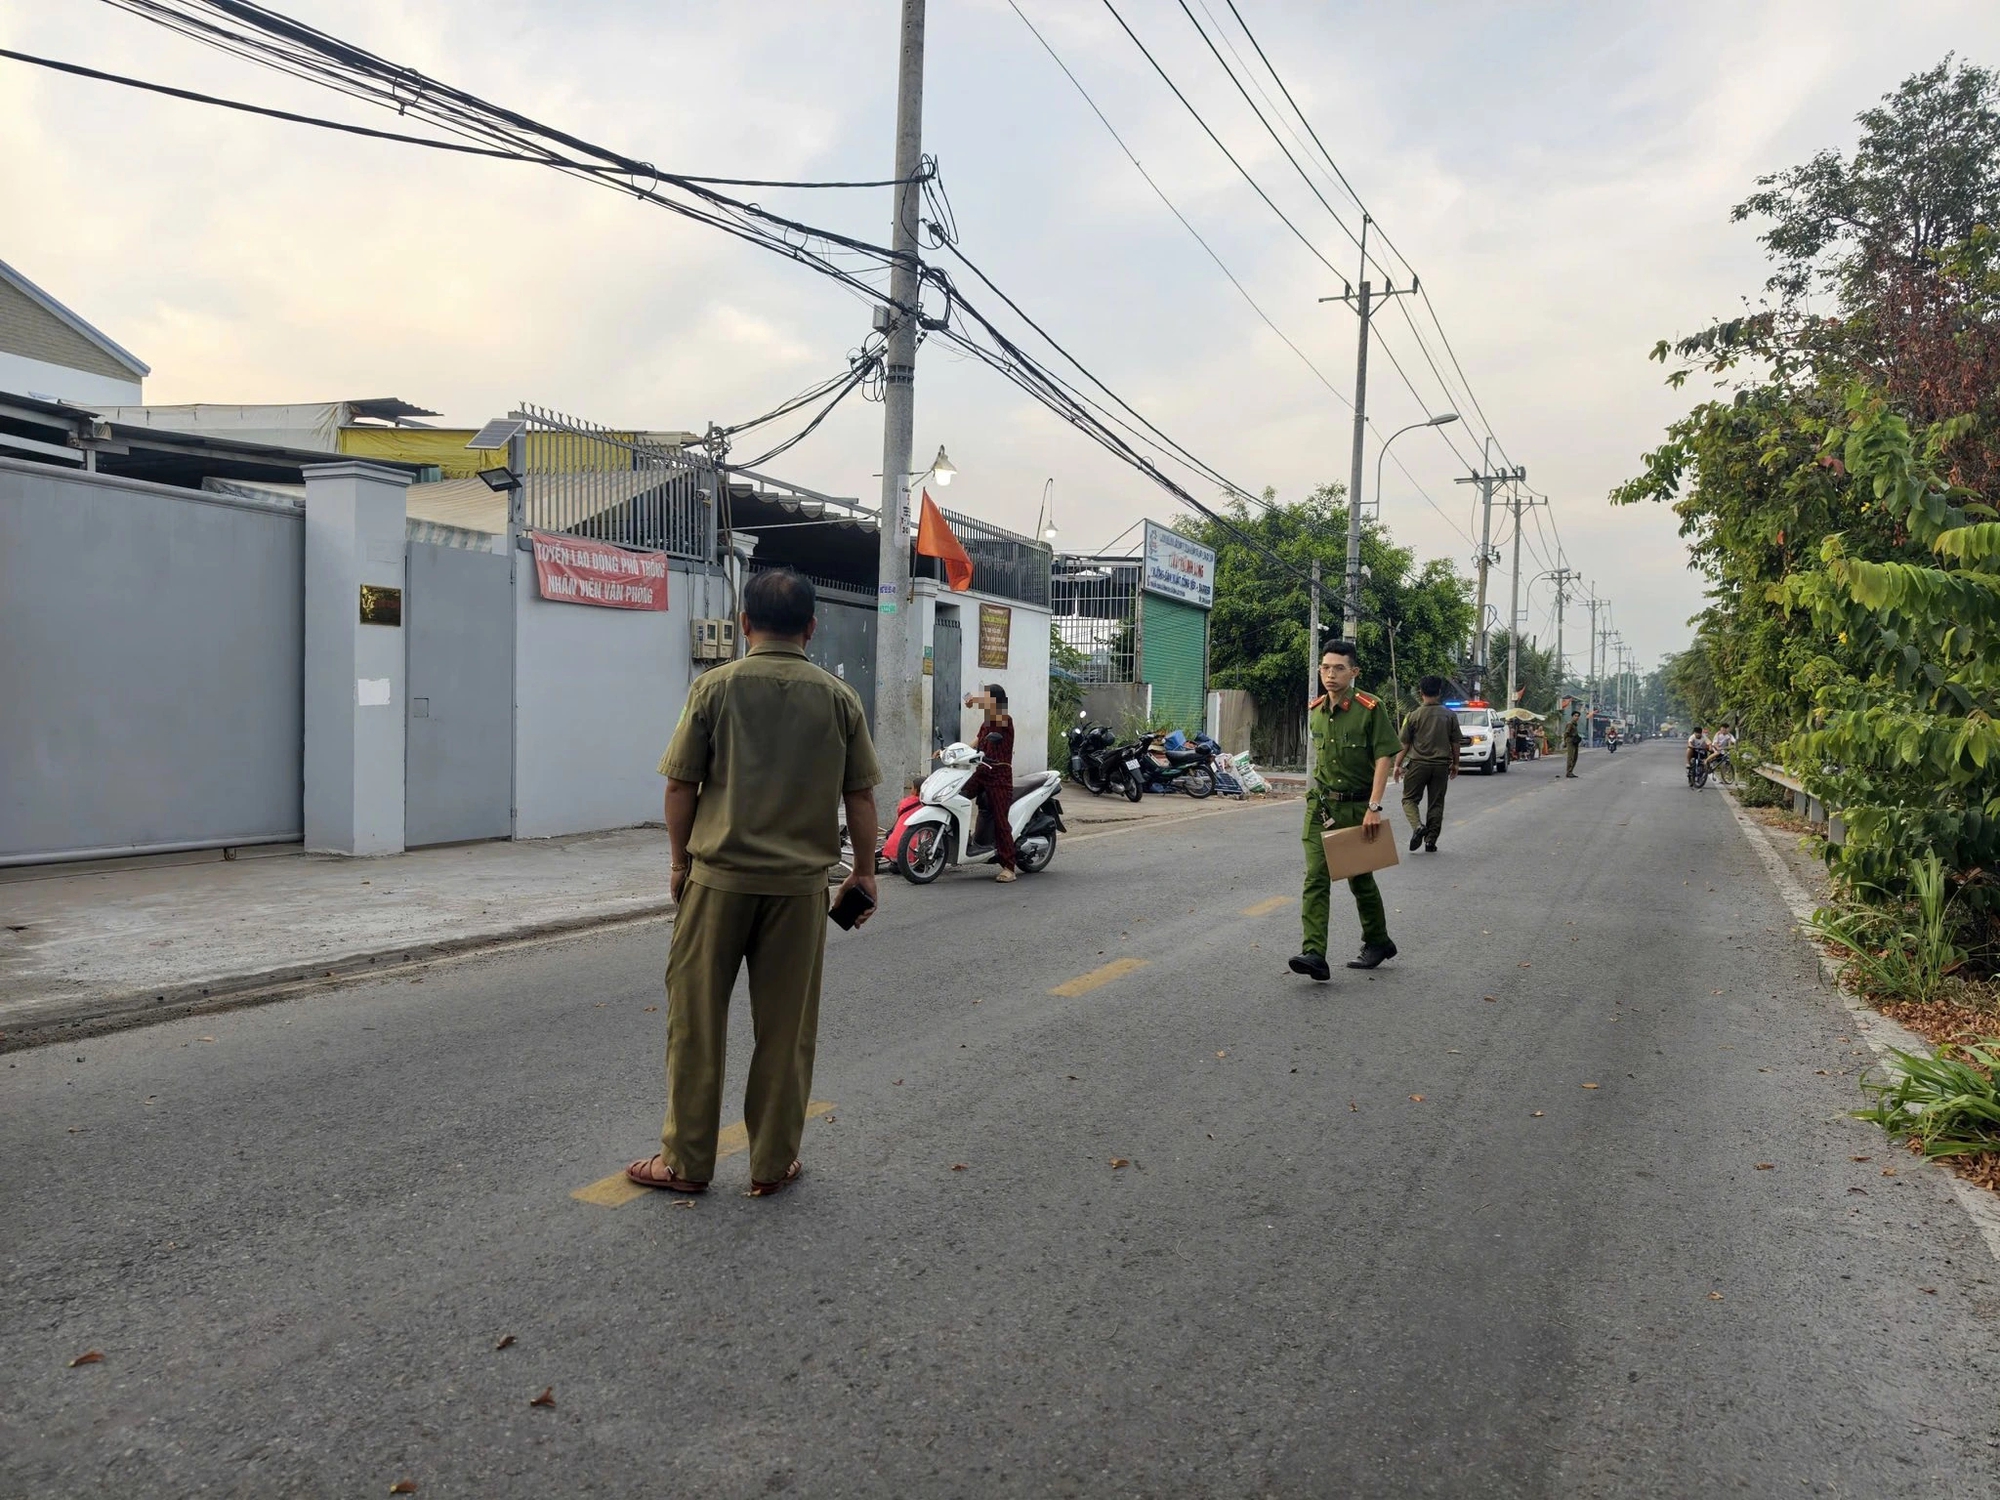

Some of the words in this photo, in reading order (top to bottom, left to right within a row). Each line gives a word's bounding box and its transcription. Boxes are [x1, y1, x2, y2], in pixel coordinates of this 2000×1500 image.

[571, 550, 590, 568] LAO
[547, 573, 577, 596] NHÂN
[578, 577, 602, 599] VIÊN
[604, 580, 624, 601] VĂN
